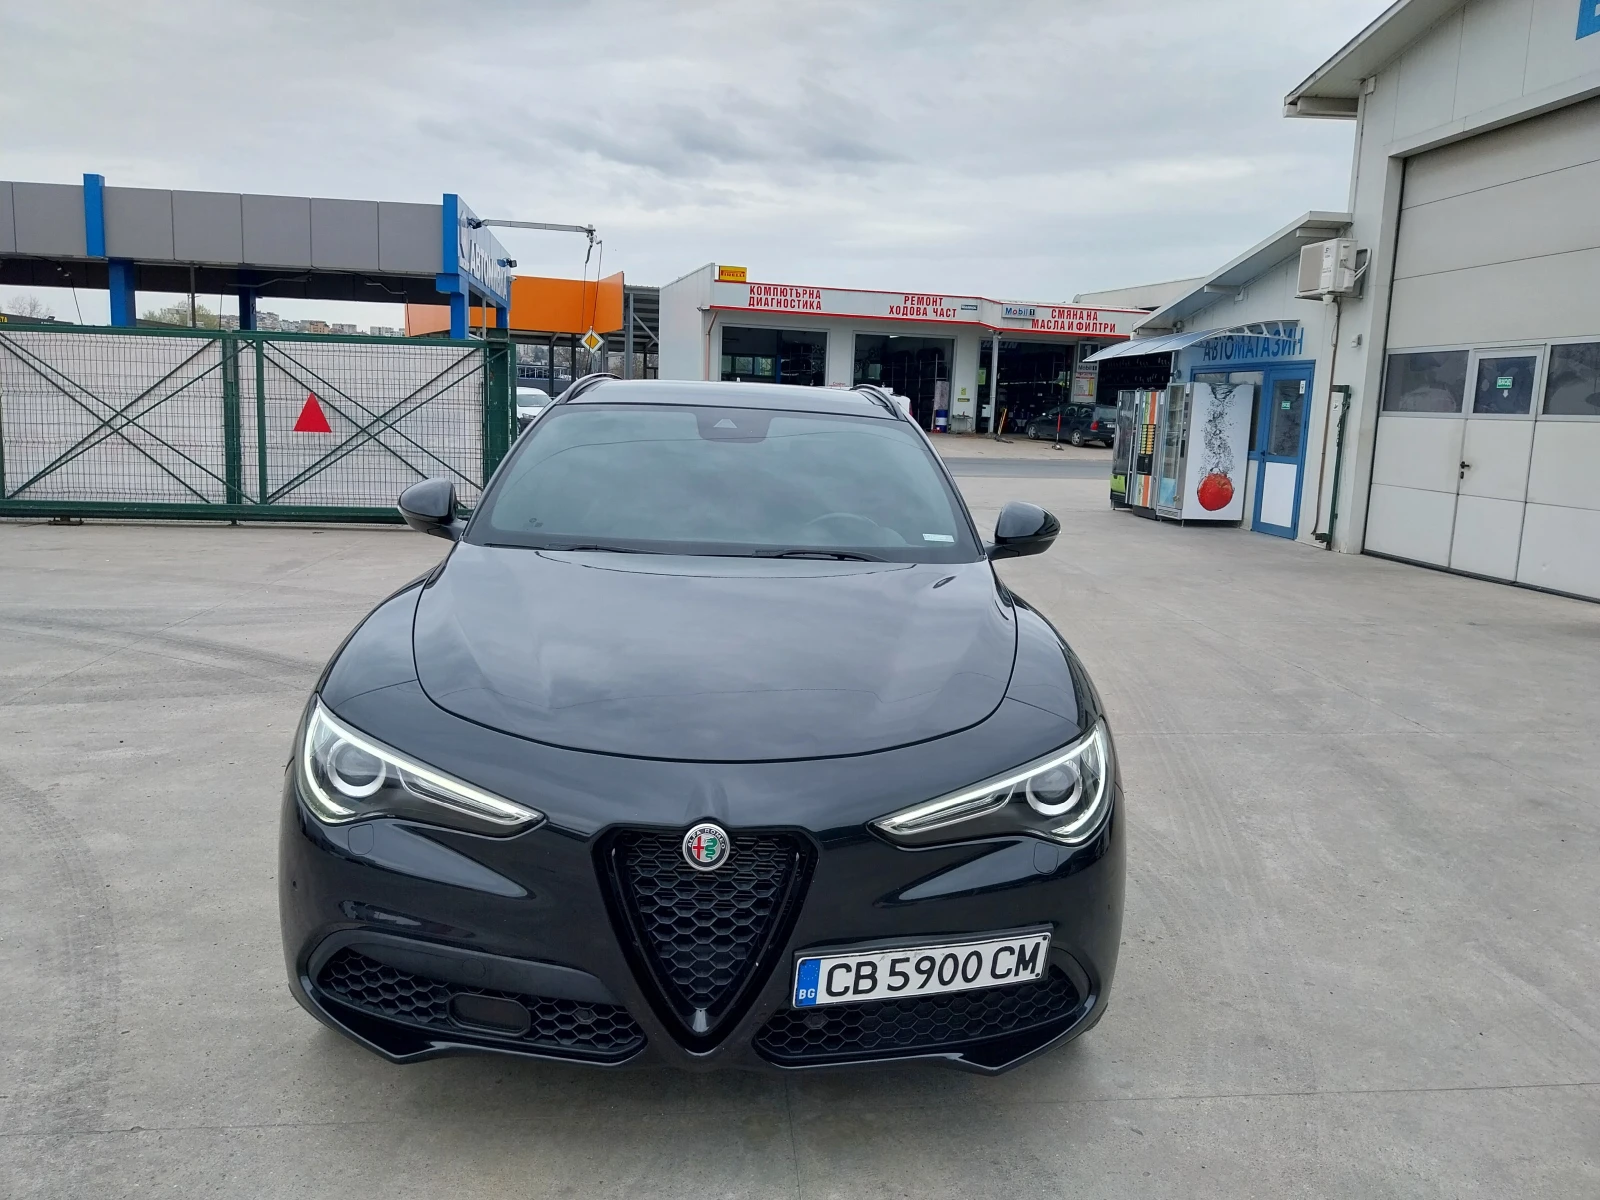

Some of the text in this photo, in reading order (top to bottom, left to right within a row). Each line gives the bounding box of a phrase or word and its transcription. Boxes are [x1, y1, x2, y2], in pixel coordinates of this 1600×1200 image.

[749, 285, 822, 300] КОМПЮТЪРНА
[748, 296, 822, 311] ДИАГНОСТИКА
[903, 295, 944, 307] РЕМОНТ
[888, 305, 957, 318] ХОДОВА ЧАСТ
[1005, 307, 1028, 317] Mobil
[1051, 308, 1098, 321] СМЯНА НА
[1031, 318, 1116, 333] МАСЛА И ФИЛТРИ
[687, 828, 726, 850] ALFA ROMEO
[825, 941, 1041, 998] CB 5900 CM
[798, 988, 816, 1000] BG
